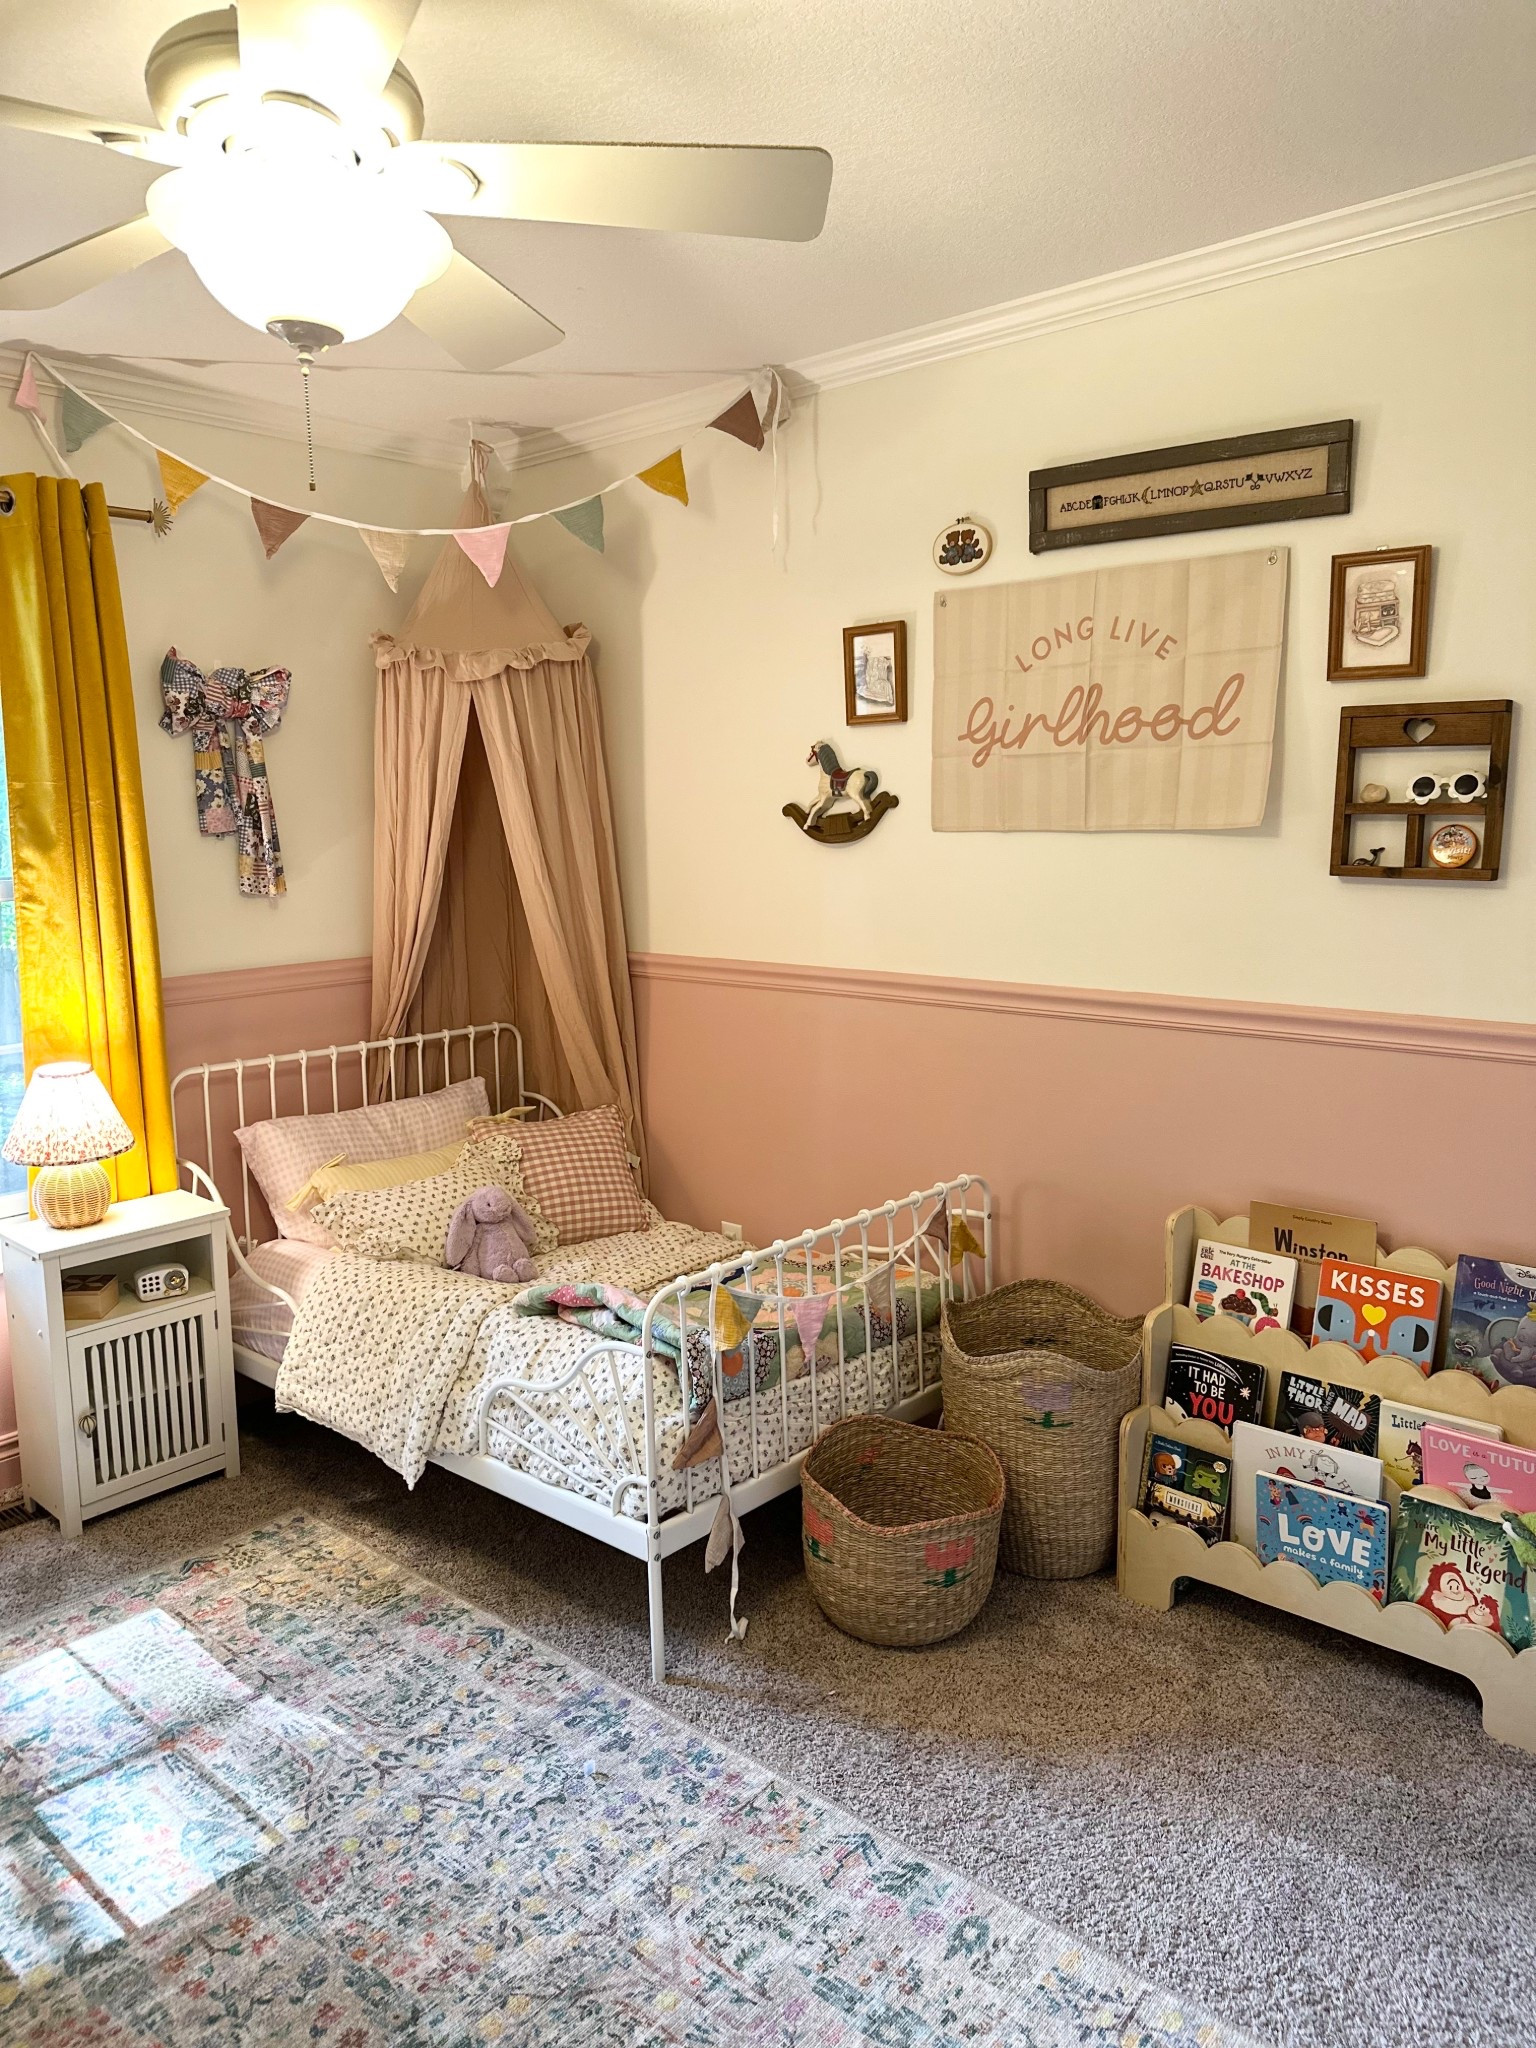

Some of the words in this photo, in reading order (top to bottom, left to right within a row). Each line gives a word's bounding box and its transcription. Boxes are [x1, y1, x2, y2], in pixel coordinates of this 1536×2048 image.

[1015, 616, 1094, 673] LONG
[1110, 616, 1178, 661] LIVE
[1273, 1226, 1349, 1262] Winston
[1200, 1262, 1285, 1292] BAKESHOP
[1230, 1260, 1240, 1268] AT
[1242, 1261, 1256, 1271] THE
[1330, 1269, 1425, 1308] KISSES
[1474, 1278, 1496, 1290] Good
[1188, 1365, 1201, 1380] IT
[1202, 1370, 1226, 1387] HAD
[1194, 1380, 1208, 1395] TO
[1210, 1385, 1226, 1400] BE
[1289, 1376, 1325, 1398] LITTLE
[1189, 1391, 1234, 1425] YOU
[1287, 1385, 1323, 1412] THOR
[1330, 1396, 1368, 1431] MAD
[1391, 1414, 1421, 1431] Little
[1265, 1446, 1281, 1459] IN
[1283, 1446, 1306, 1460] MY
[1429, 1436, 1471, 1458] LOVE
[1487, 1451, 1535, 1475] TUTU
[1278, 1512, 1372, 1568] LOVE
[1424, 1531, 1448, 1556] My
[1450, 1534, 1486, 1559] Little
[1283, 1545, 1317, 1561] makes
[1330, 1559, 1365, 1580] family
[1466, 1555, 1528, 1593] Legend
